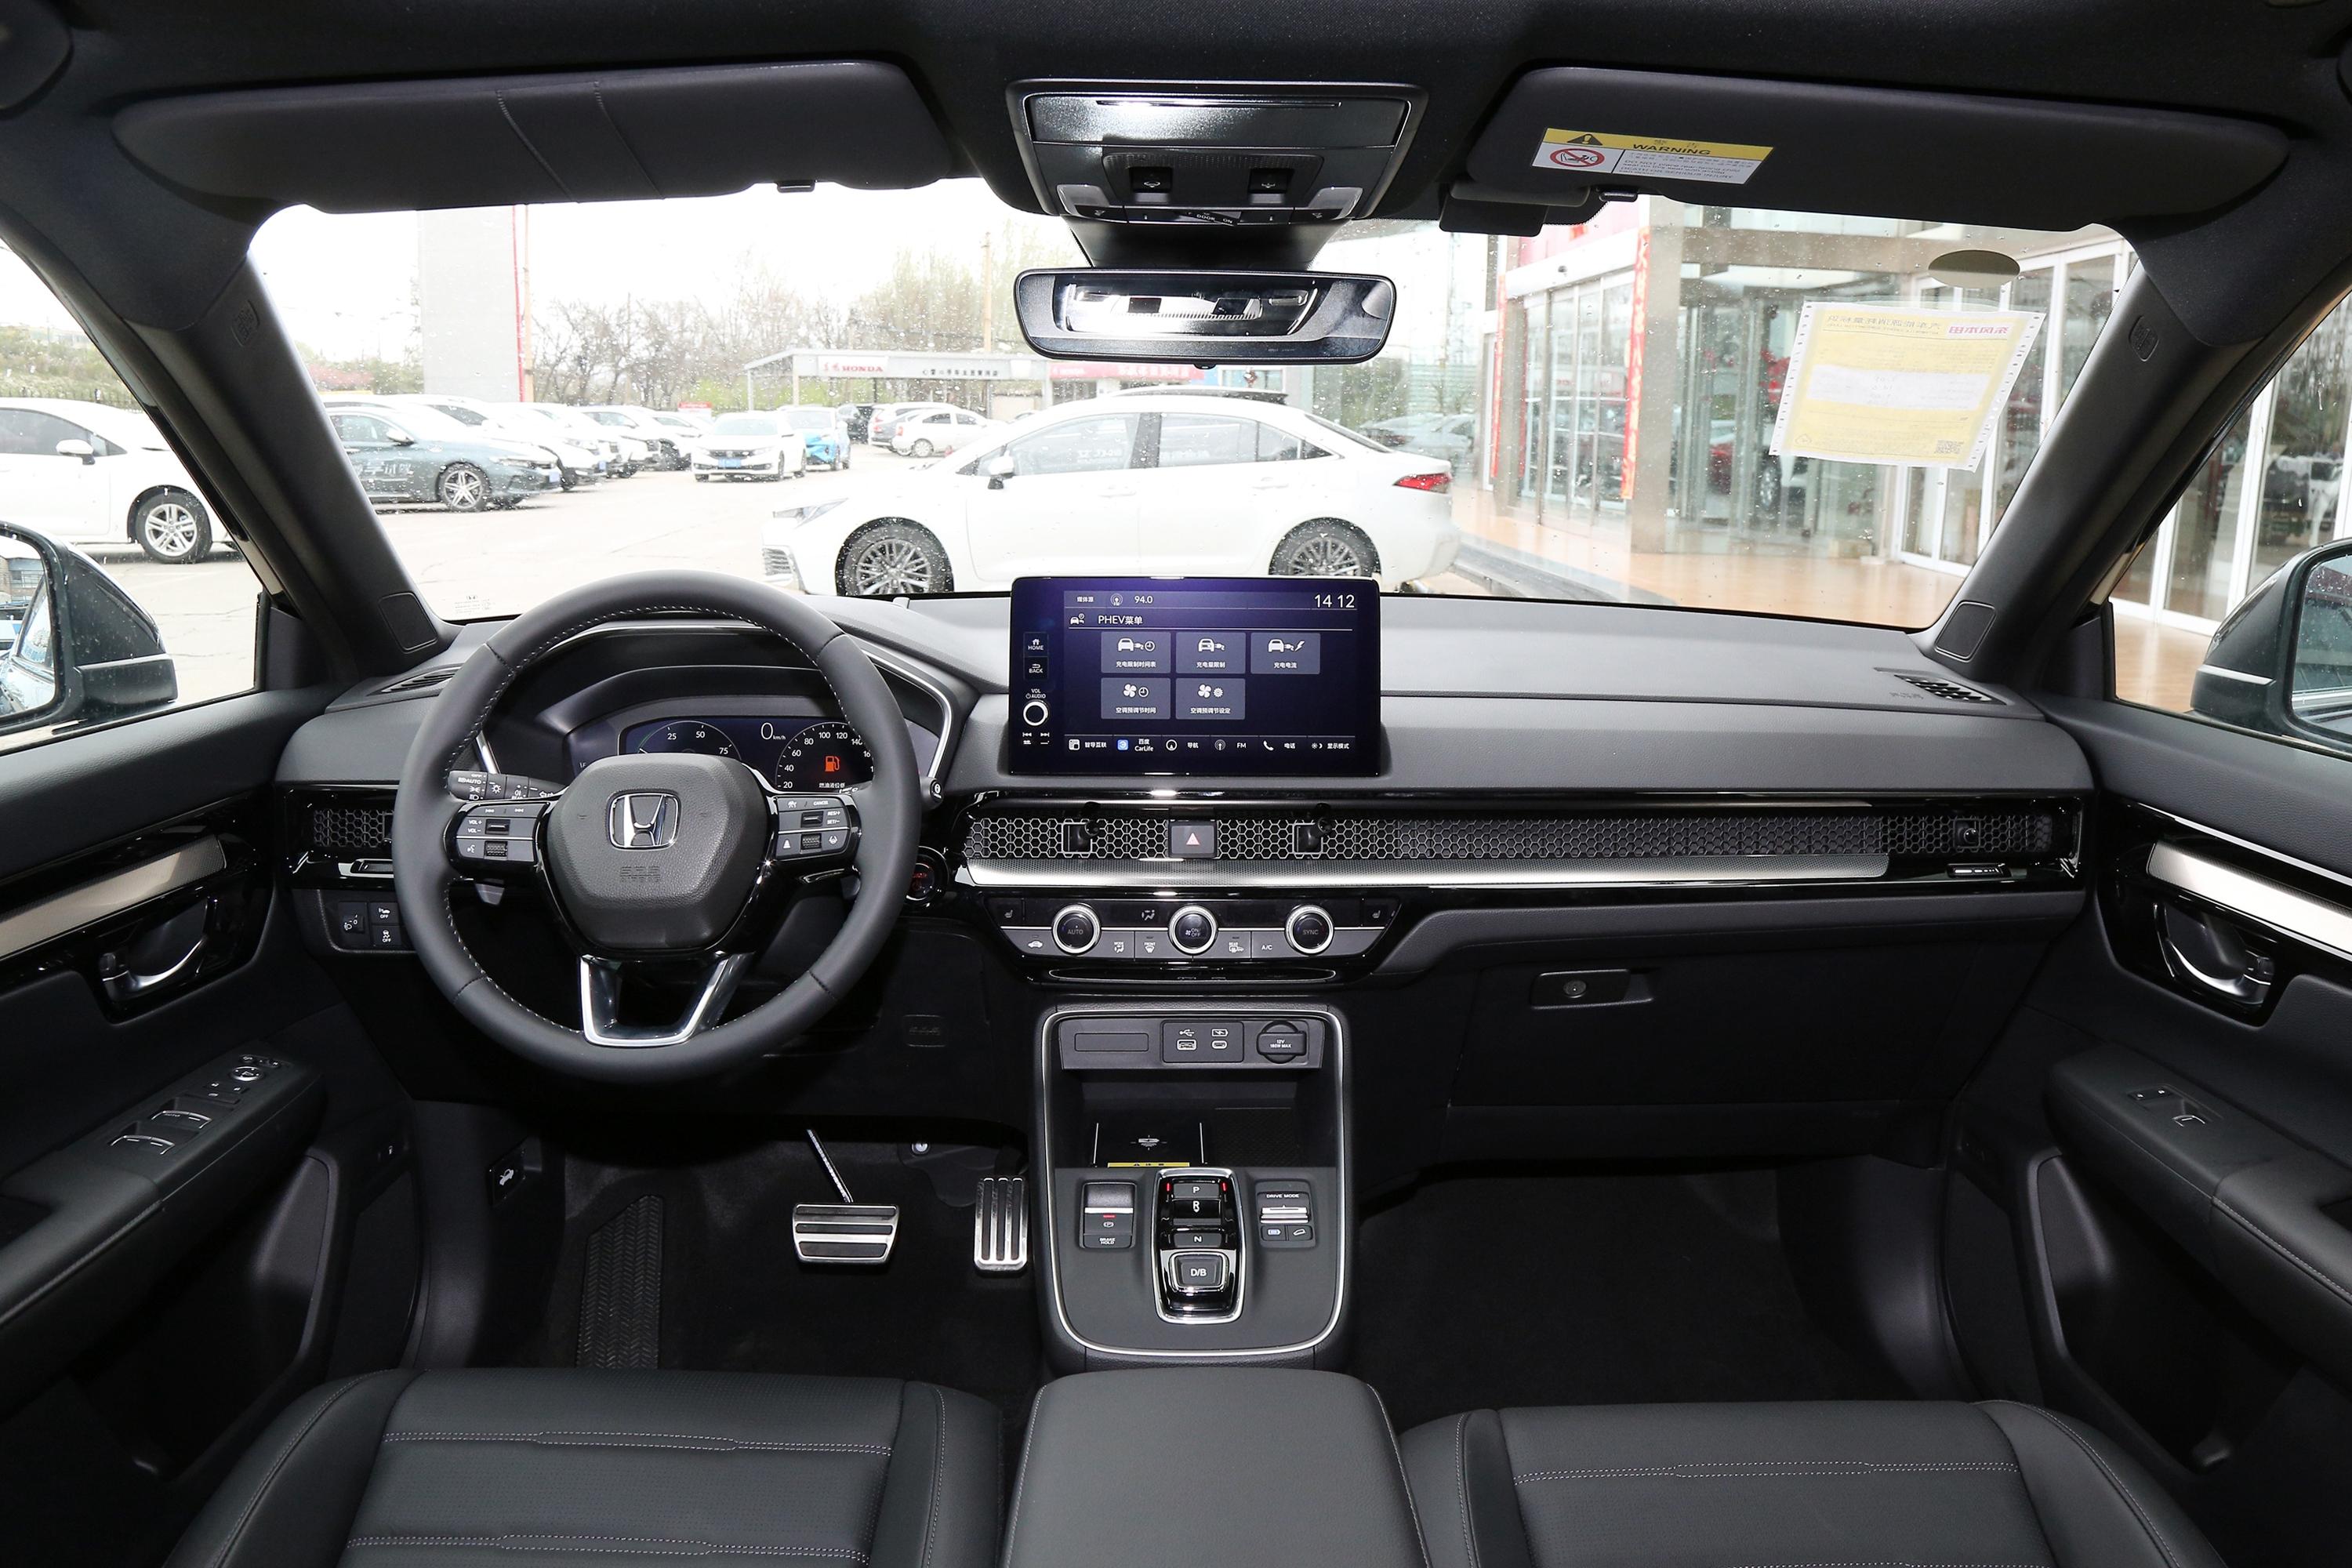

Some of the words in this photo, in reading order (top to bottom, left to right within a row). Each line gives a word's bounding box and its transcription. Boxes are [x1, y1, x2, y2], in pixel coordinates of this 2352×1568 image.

[1633, 143, 1711, 155] WARNING
[1315, 594, 1333, 608] 14
[1338, 594, 1356, 608] 12
[1098, 615, 1143, 625] PHEV菜单
[760, 722, 774, 740] 0
[1190, 1269, 1207, 1277] D/B
